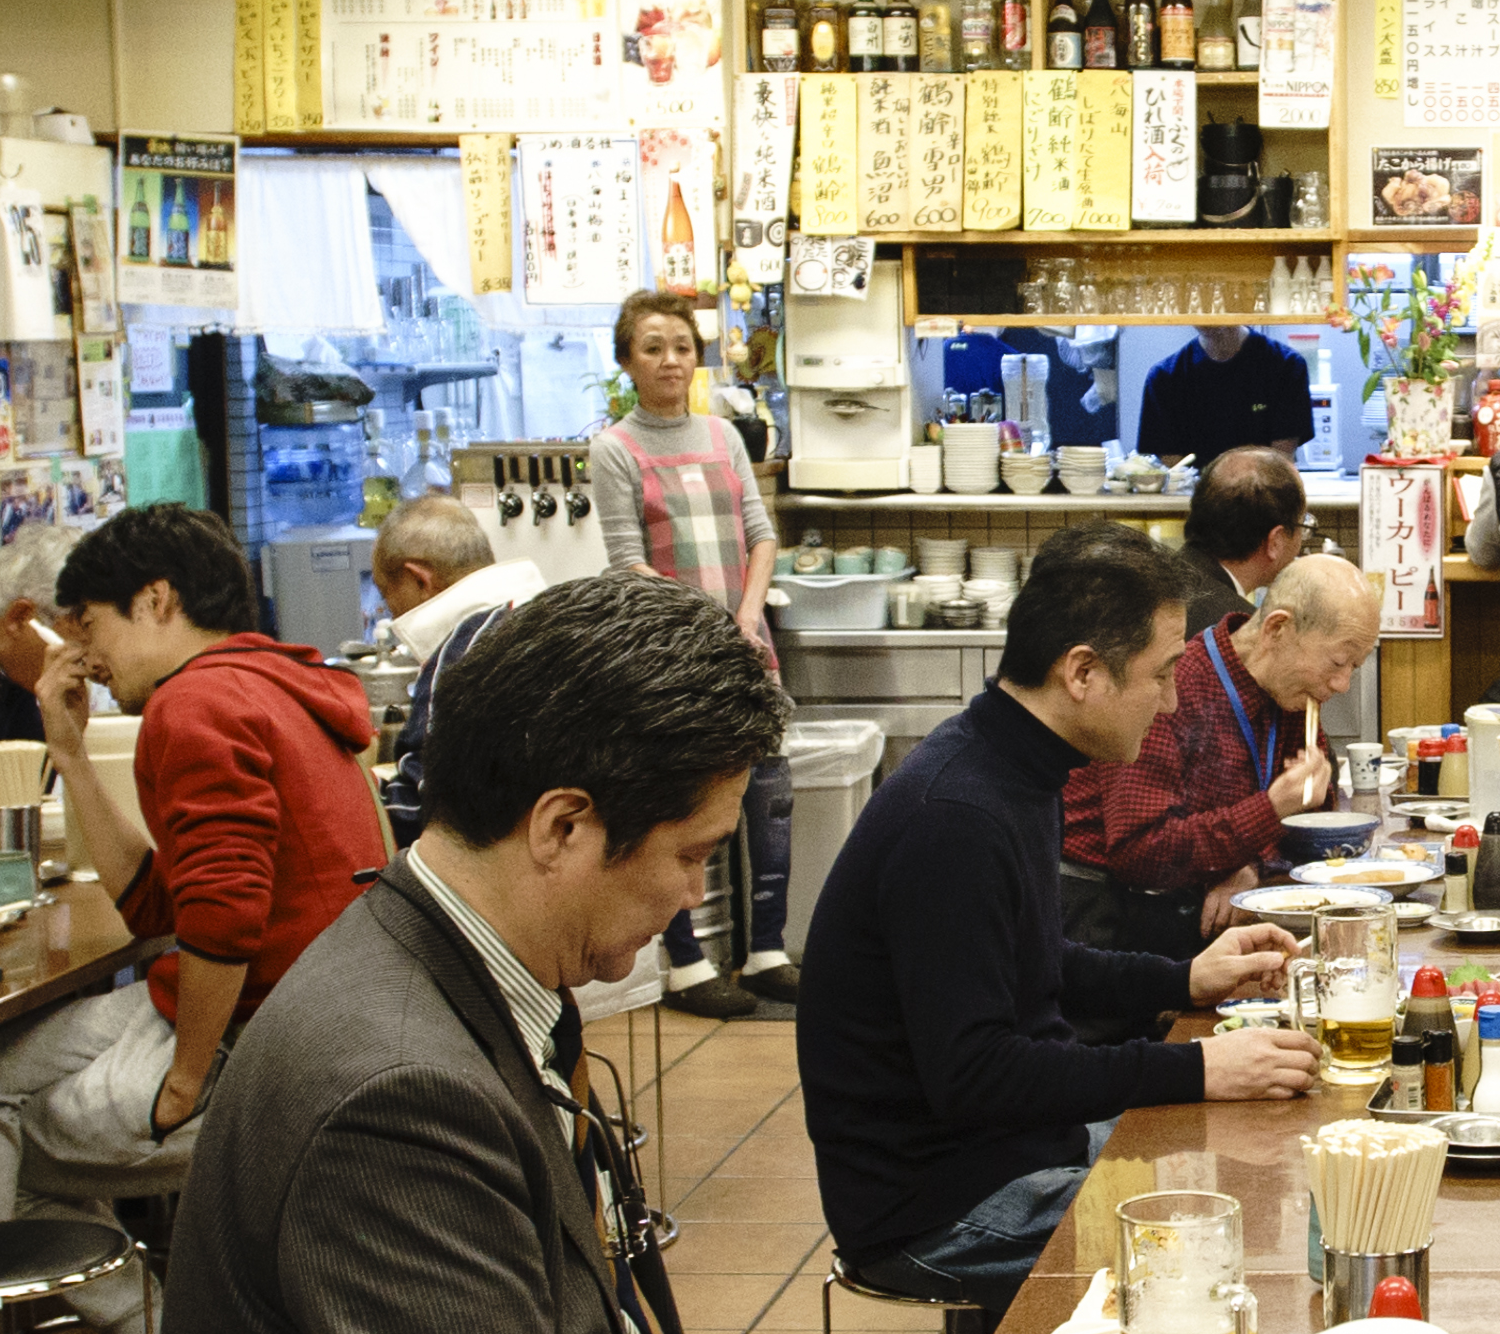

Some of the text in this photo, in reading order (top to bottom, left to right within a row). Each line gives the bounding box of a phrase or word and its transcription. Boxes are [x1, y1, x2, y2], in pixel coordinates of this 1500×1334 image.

[1286, 80, 1330, 92] NIPPON
[1374, 78, 1399, 94] 850
[865, 211, 901, 229] 600
[913, 205, 958, 227] 600
[1386, 473, 1418, 611] ウーカーピー
